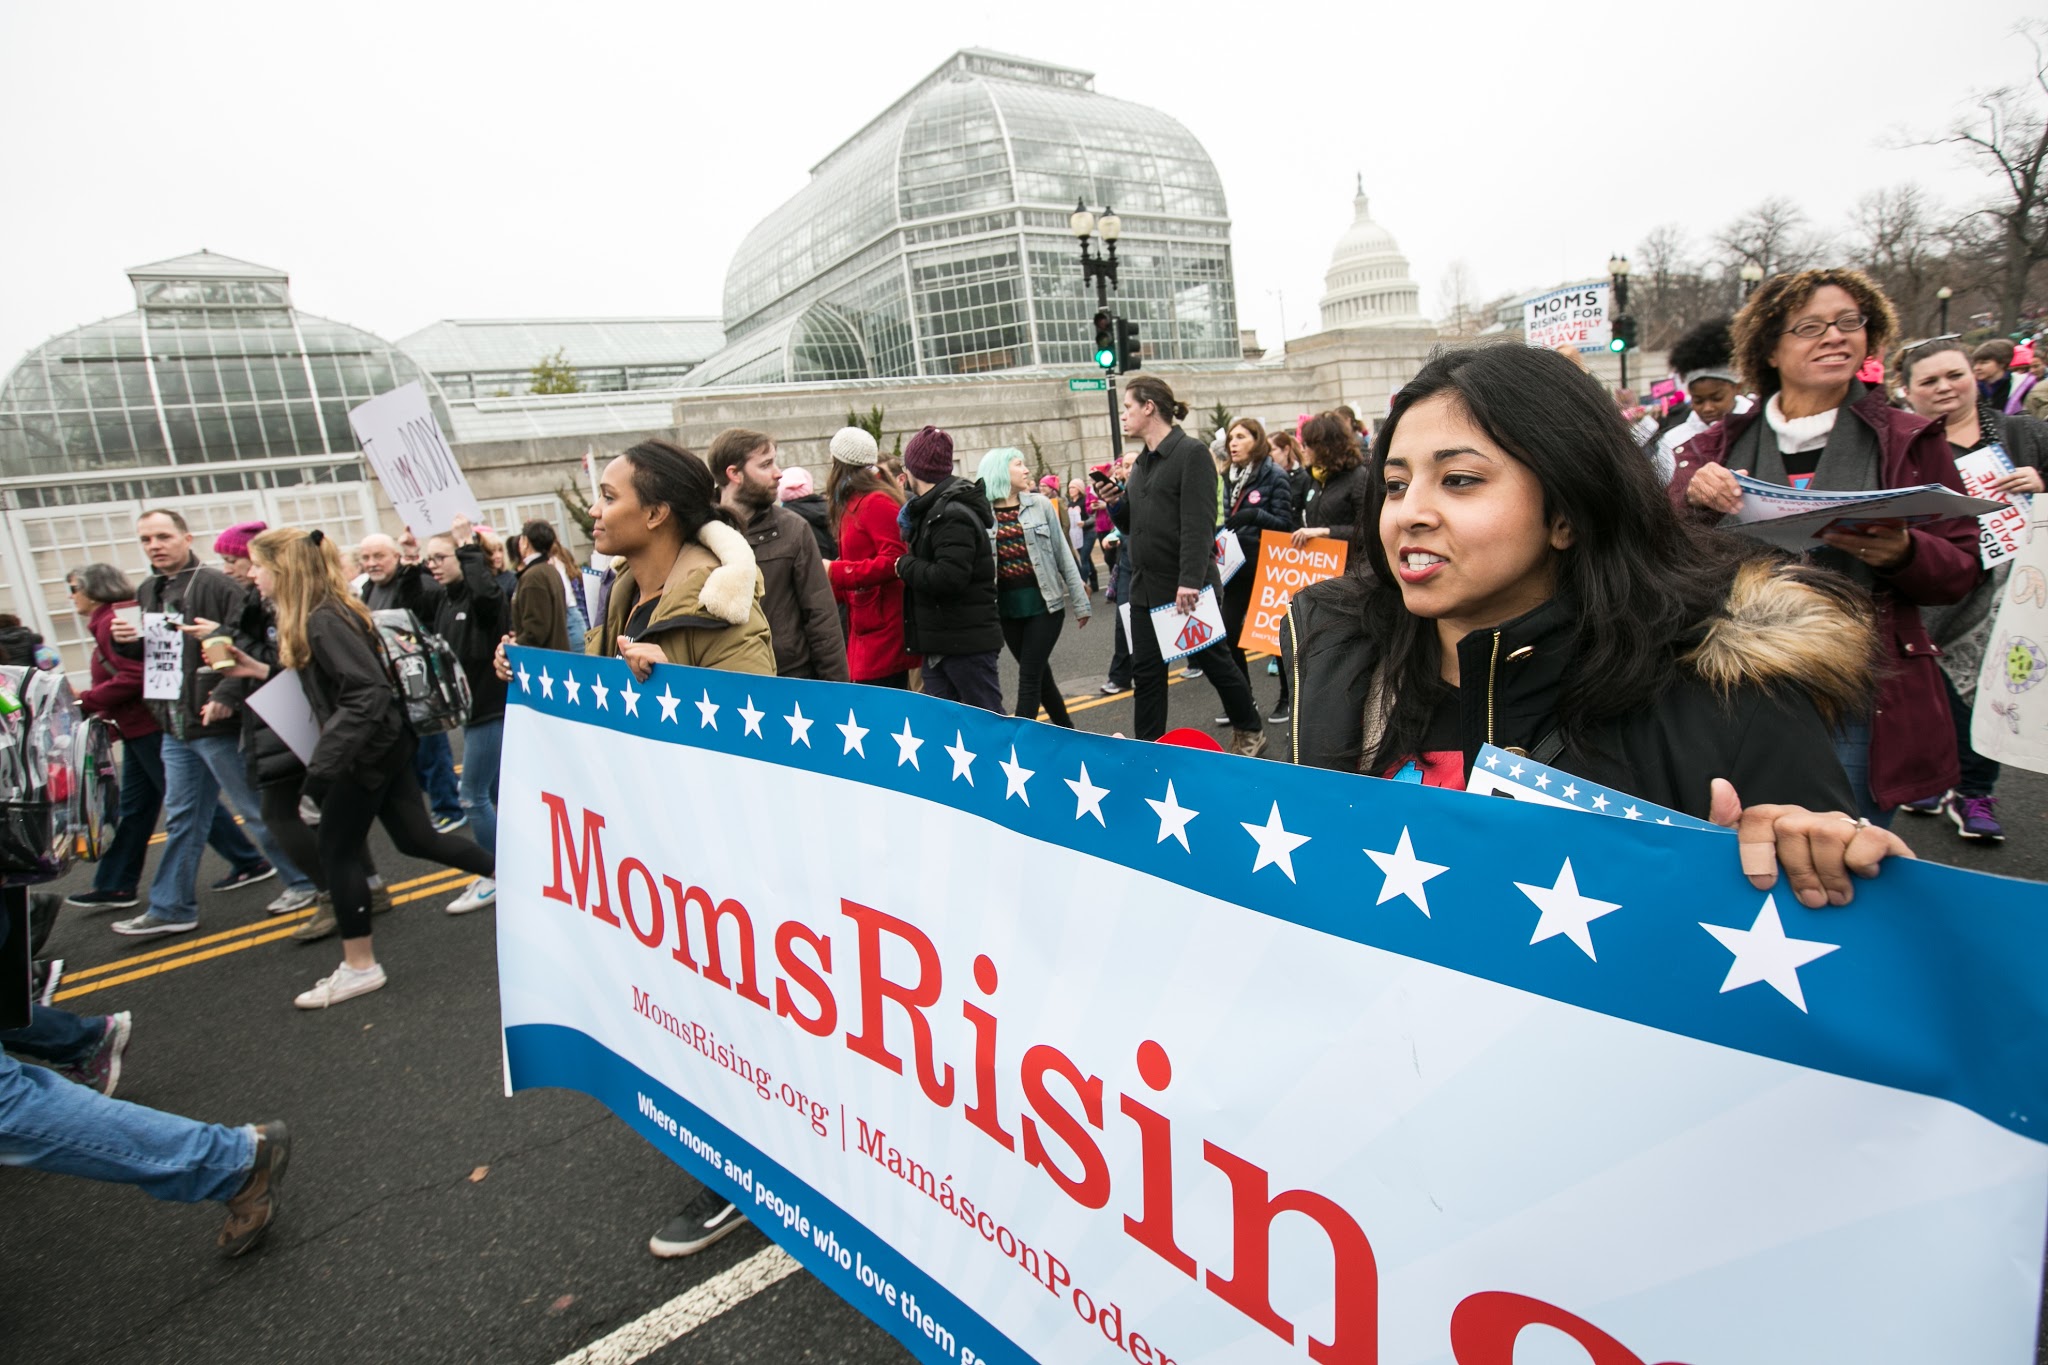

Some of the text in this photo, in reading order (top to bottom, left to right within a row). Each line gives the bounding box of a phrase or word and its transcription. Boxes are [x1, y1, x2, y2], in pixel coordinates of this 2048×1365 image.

[1534, 291, 1598, 318] MOMS
[1530, 308, 1602, 331] RISING FOR
[1531, 319, 1602, 340] PAID FAMILY
[1542, 329, 1588, 349] LEAVE
[398, 412, 461, 495] BODY
[1990, 519, 2019, 552] PAID
[1267, 545, 1339, 570] WOMEN
[1260, 586, 1291, 609] BA
[153, 652, 177, 660] WITH
[158, 641, 172, 650] I'M
[156, 663, 174, 672] HER
[632, 984, 829, 1137] MomsRising.org
[638, 1091, 677, 1137] Where
[680, 1125, 722, 1170] moms
[725, 1158, 753, 1193] and
[756, 1181, 810, 1238] people
[814, 1224, 851, 1271] who
[856, 1252, 896, 1306] love
[901, 1291, 956, 1358] them
